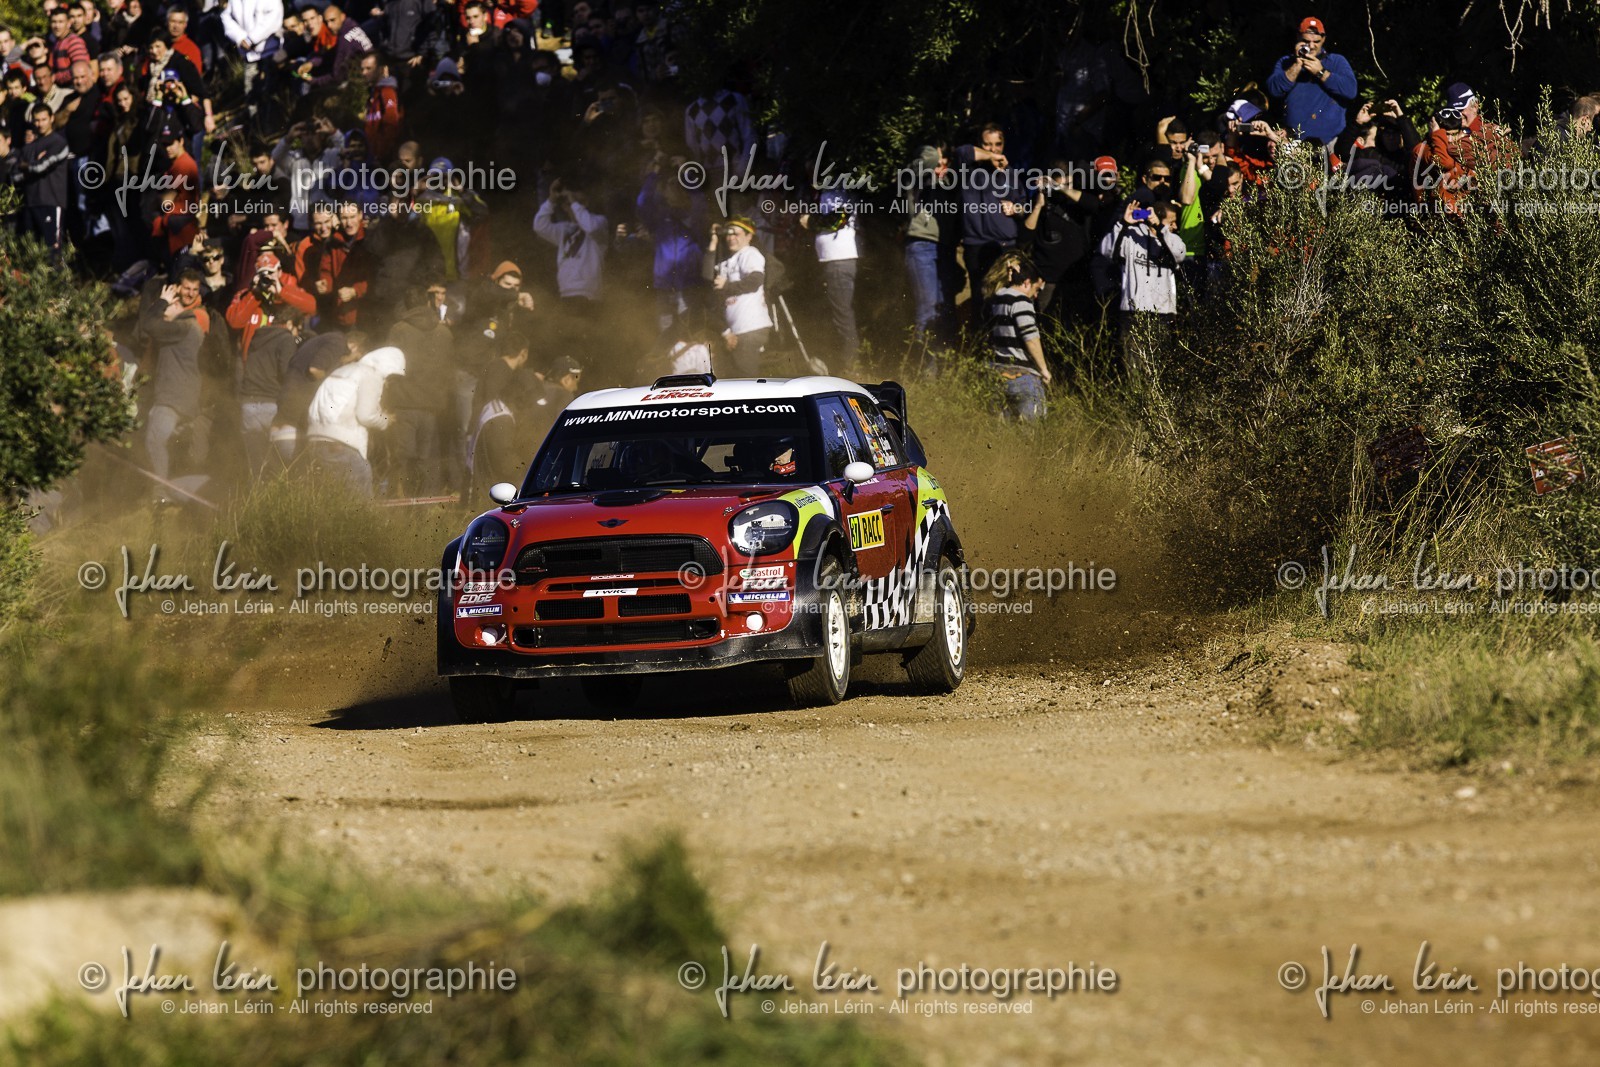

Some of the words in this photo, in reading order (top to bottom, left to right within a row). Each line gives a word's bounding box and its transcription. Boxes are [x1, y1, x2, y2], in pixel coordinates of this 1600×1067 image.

[563, 402, 796, 427] www.MINImotorsport.com
[861, 514, 882, 545] RACC
[750, 567, 781, 578] Castrol
[458, 592, 496, 605] EDGE
[743, 592, 787, 600] MICHELIN
[468, 606, 500, 615] MICHELIN
